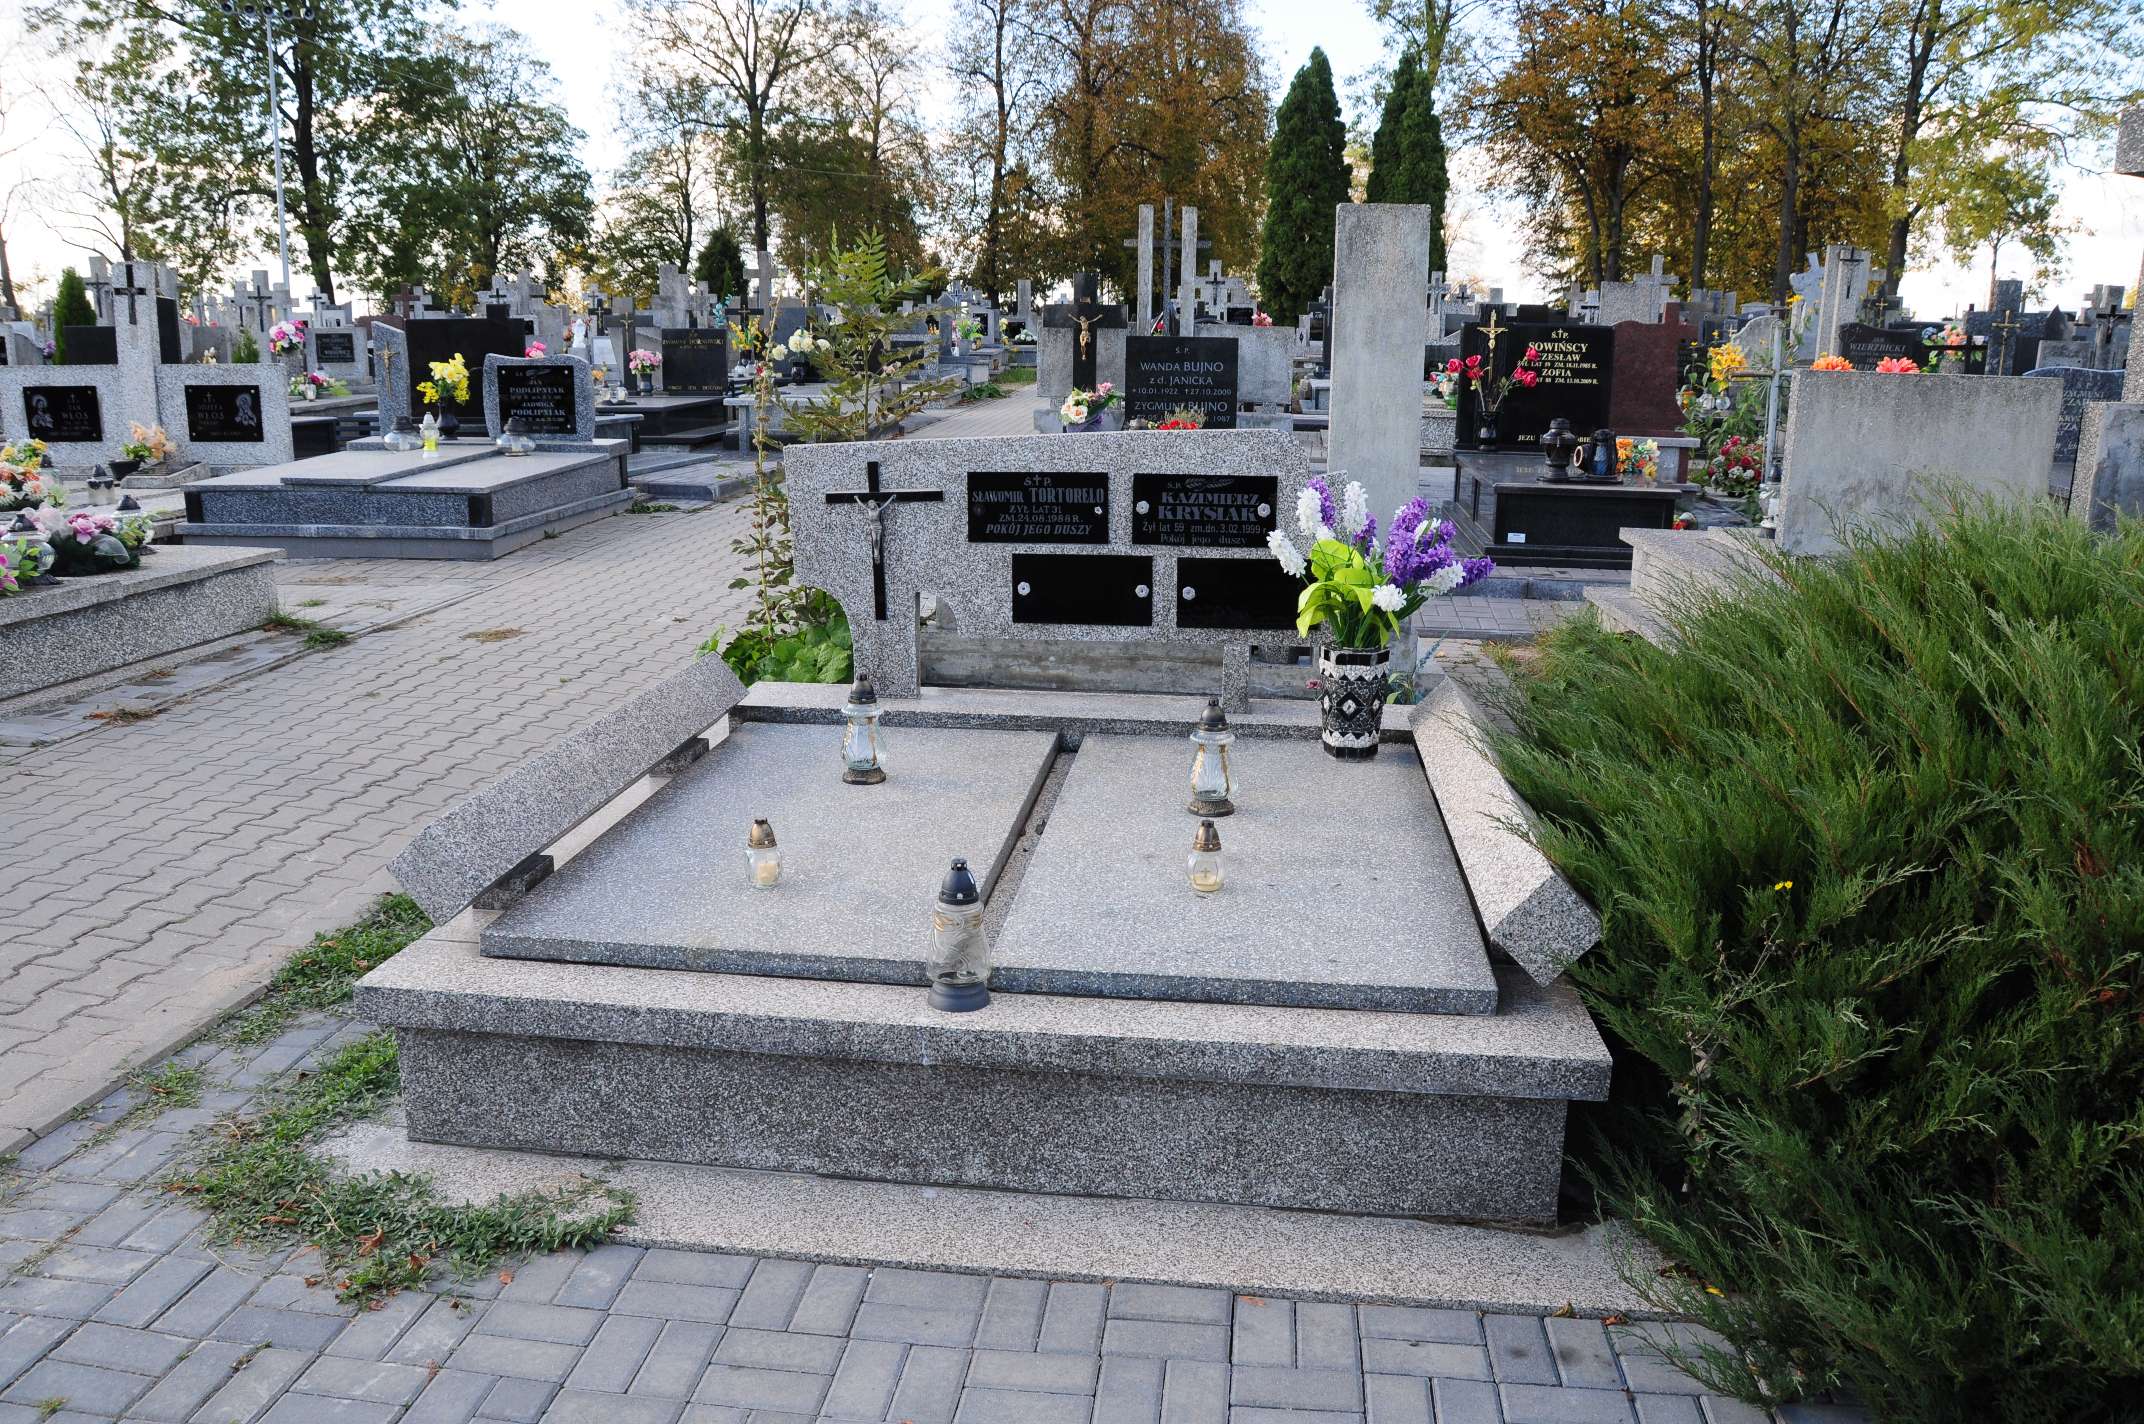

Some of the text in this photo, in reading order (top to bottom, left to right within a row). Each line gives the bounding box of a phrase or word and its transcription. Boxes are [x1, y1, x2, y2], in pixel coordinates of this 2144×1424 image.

[1528, 340, 1588, 352] SOWIŃSCY
[1140, 361, 1224, 374] WANDA BUJNO
[1541, 368, 1572, 377] ZOFIA
[1169, 376, 1213, 386] JANICKA
[509, 386, 566, 394] PODLIPNIAK
[510, 408, 567, 416] PODLIPNIAK
[972, 487, 1105, 504] SŁAWOMIR TORTORELO
[1161, 491, 1261, 506] KAZIMIERZ
[1032, 504, 1050, 515] LAT
[1158, 505, 1258, 522] KRYSIAK
[985, 523, 1092, 537] POKÓJ JEGO DUSZY
[1159, 522, 1171, 533] lat
